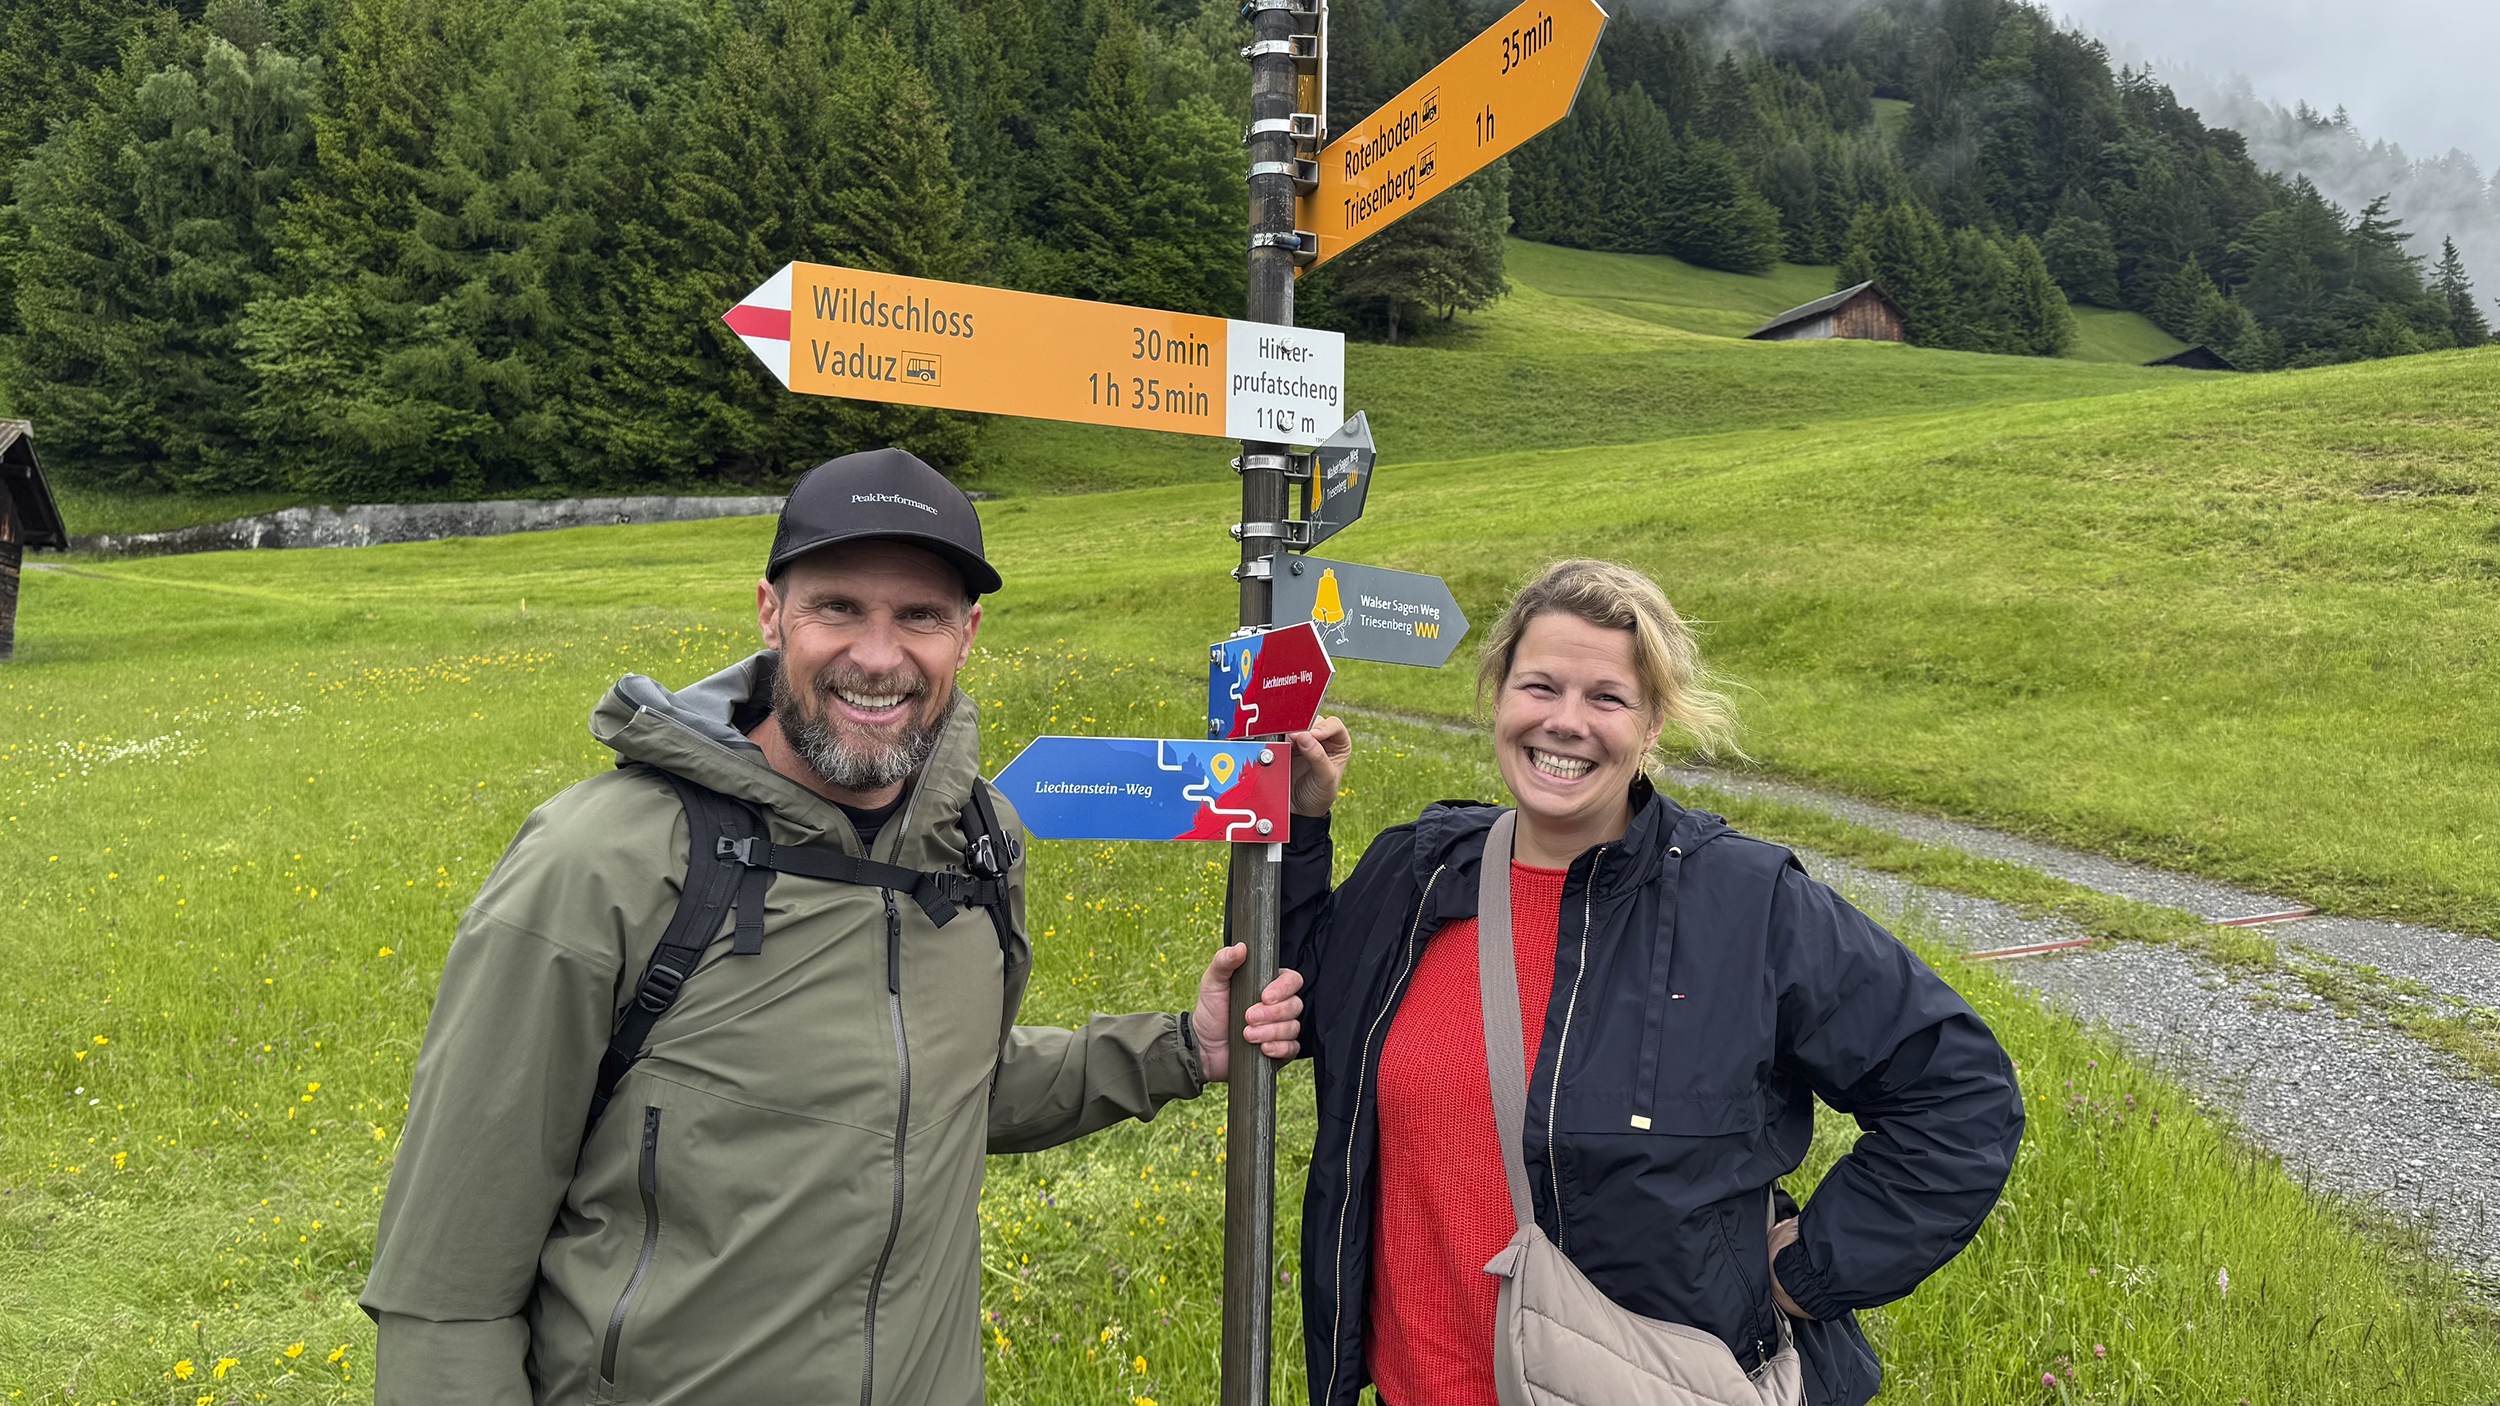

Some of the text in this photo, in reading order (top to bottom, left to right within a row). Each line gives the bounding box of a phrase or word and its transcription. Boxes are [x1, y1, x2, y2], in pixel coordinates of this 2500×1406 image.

[1345, 110, 1418, 182] Rotenboden
[1344, 164, 1416, 230] Triesenberg
[812, 285, 974, 339] Wildschloss
[811, 339, 897, 382] Vaduz
[1233, 371, 1338, 407] prufatscheng
[1301, 416, 1315, 433] m
[1350, 449, 1359, 463] Weg
[1360, 594, 1440, 620] Walser Sagen Weg
[1360, 614, 1412, 636] Triesenberg
[1262, 670, 1313, 690] Liechtenstein-Weg
[1035, 781, 1153, 798] Liechtenstein-Weg
